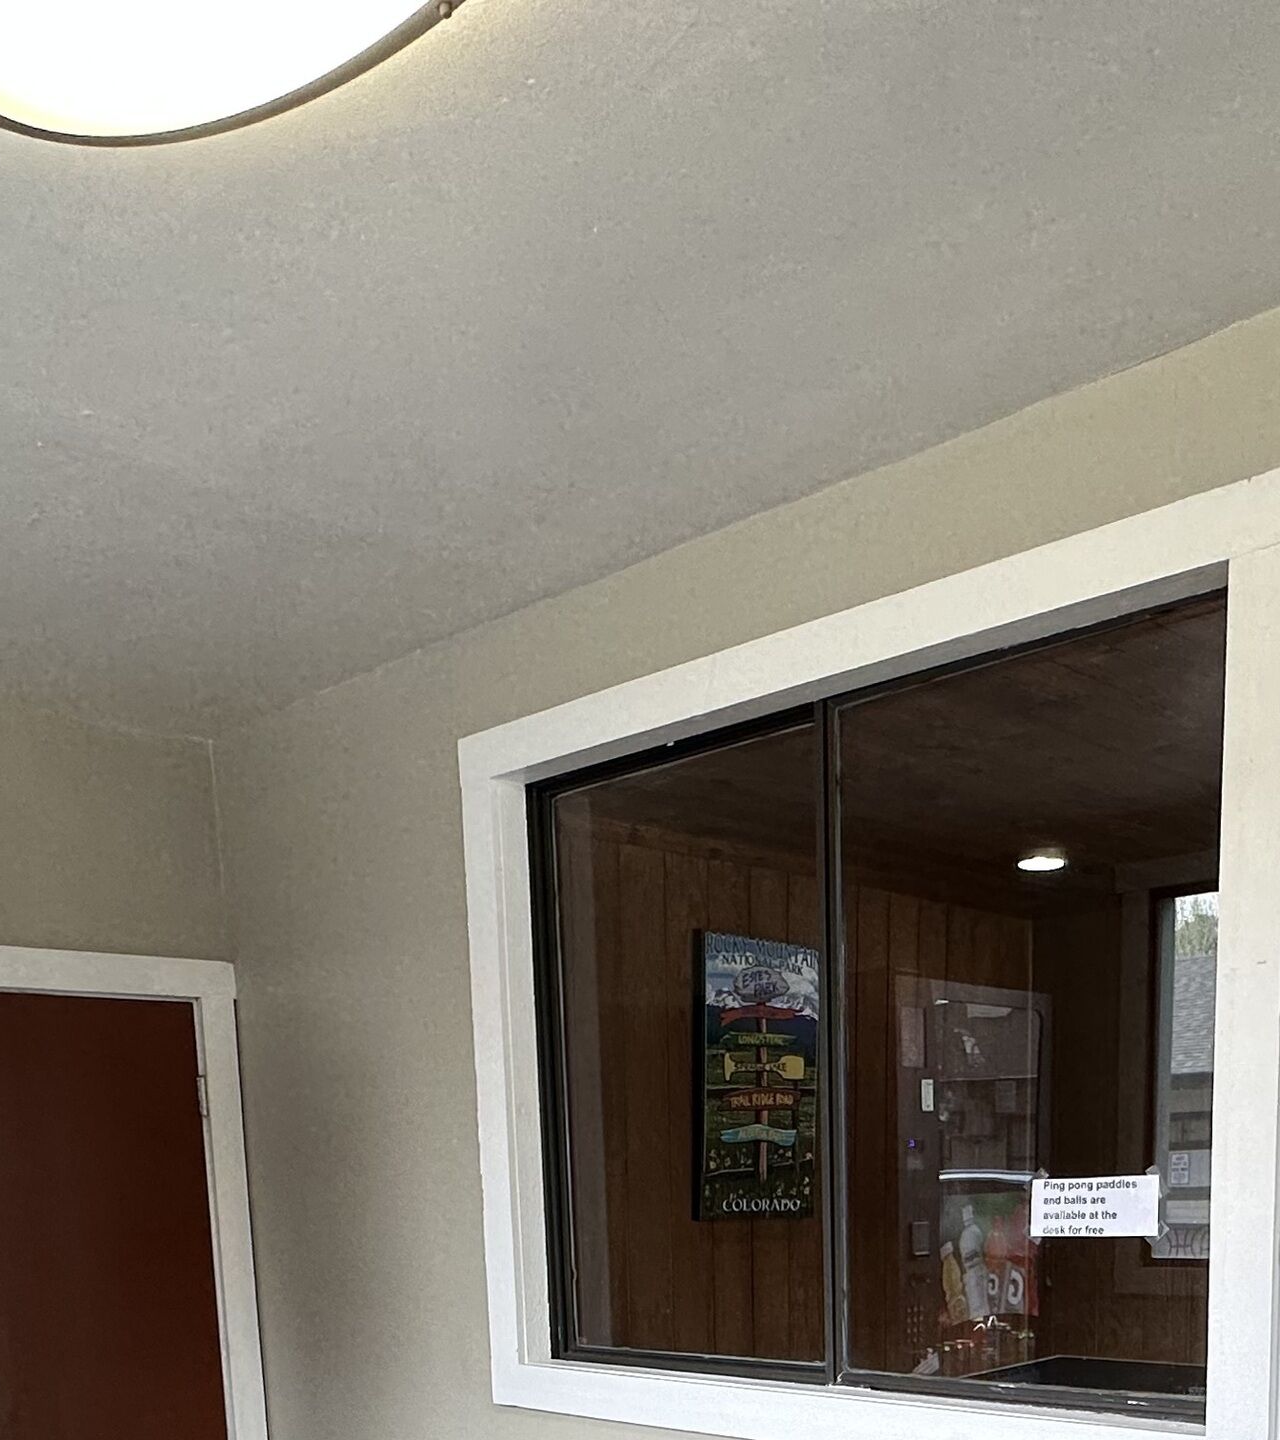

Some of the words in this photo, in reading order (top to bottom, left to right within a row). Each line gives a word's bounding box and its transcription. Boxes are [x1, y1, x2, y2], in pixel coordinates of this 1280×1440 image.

[1043, 1180, 1066, 1192] Ping
[1068, 1182, 1093, 1191] pong
[1096, 1179, 1138, 1190] paddles
[722, 1198, 801, 1212] COLORADO
[1043, 1196, 1061, 1205] and
[1064, 1195, 1087, 1205] balls
[1090, 1197, 1107, 1205] are
[1043, 1210, 1086, 1220] available
[1089, 1211, 1099, 1220] at
[1101, 1210, 1118, 1220] the
[1043, 1225, 1066, 1235] desk
[1068, 1225, 1082, 1235] for
[1085, 1225, 1105, 1235] free
